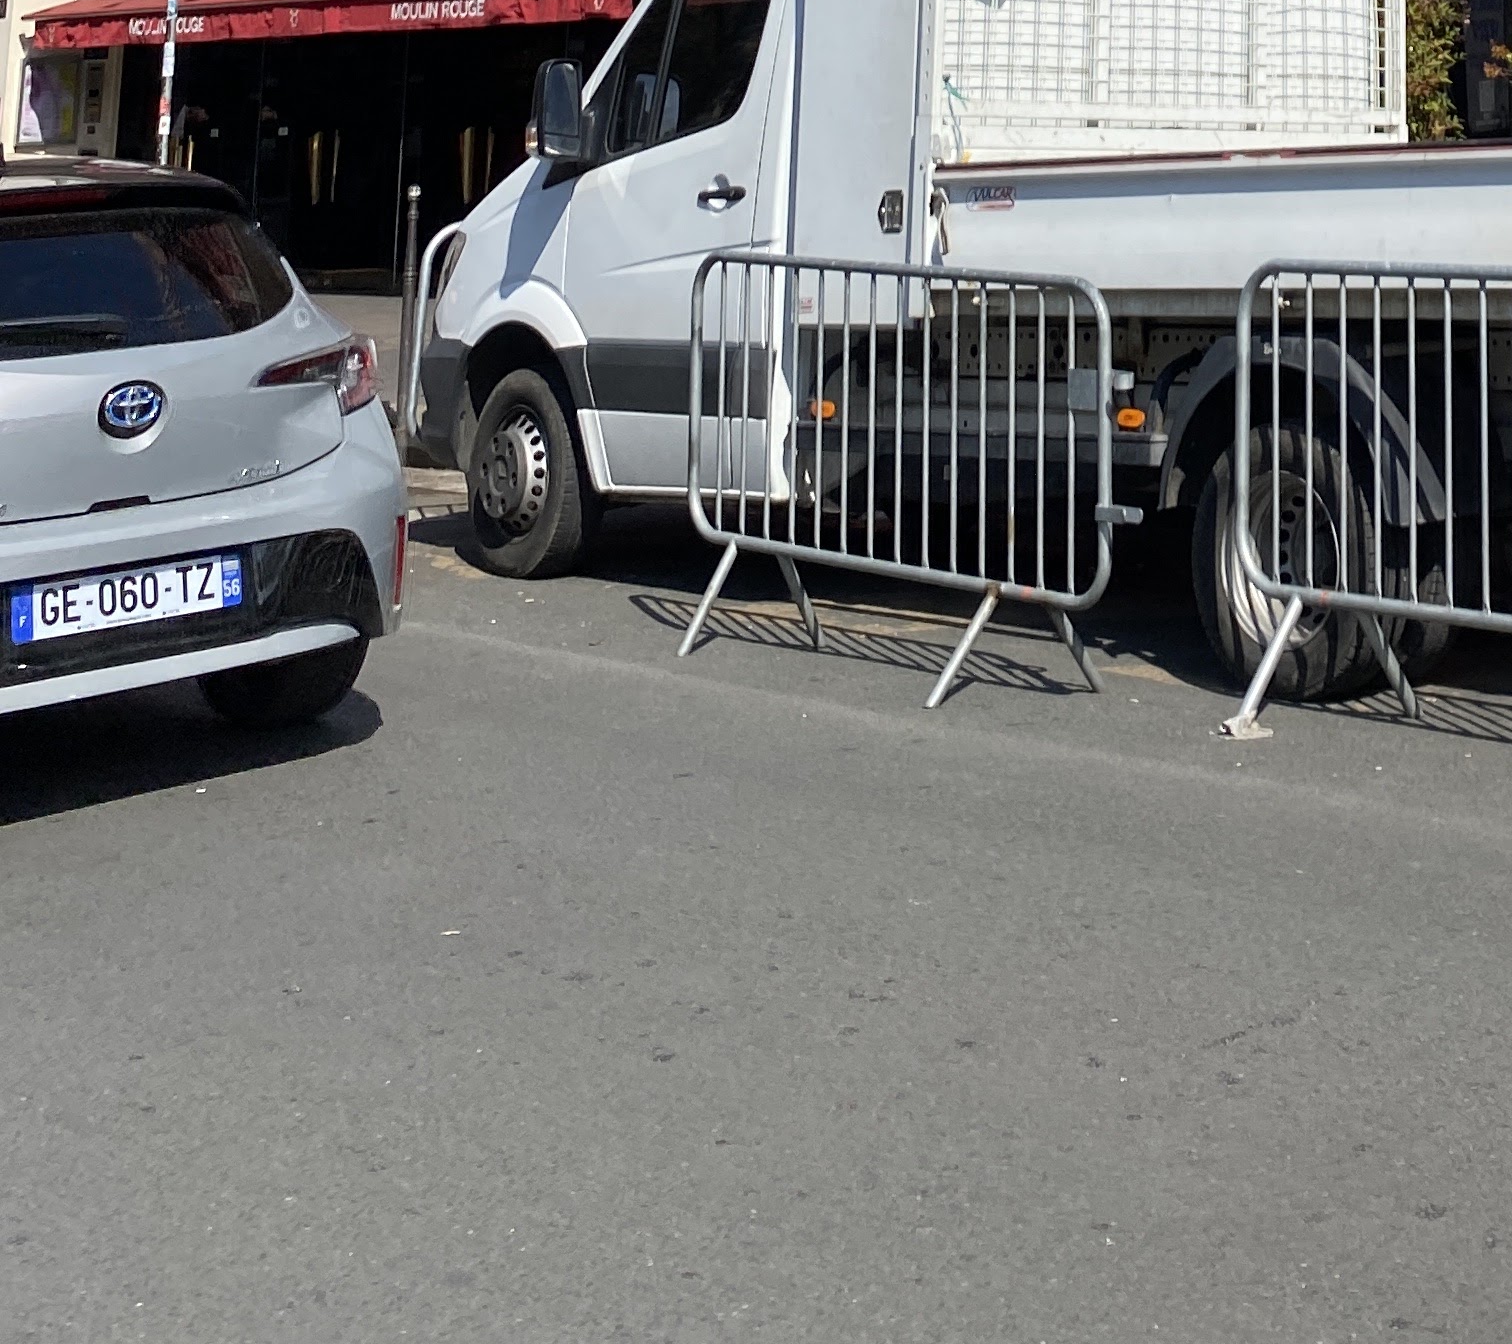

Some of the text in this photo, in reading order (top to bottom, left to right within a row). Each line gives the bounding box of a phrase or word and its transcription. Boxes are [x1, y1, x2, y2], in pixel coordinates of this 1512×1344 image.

[389, 2, 438, 21] MOULIN
[176, 15, 205, 34] OUGE
[40, 562, 216, 626] GE-060-TZ
[223, 578, 241, 598] 56
